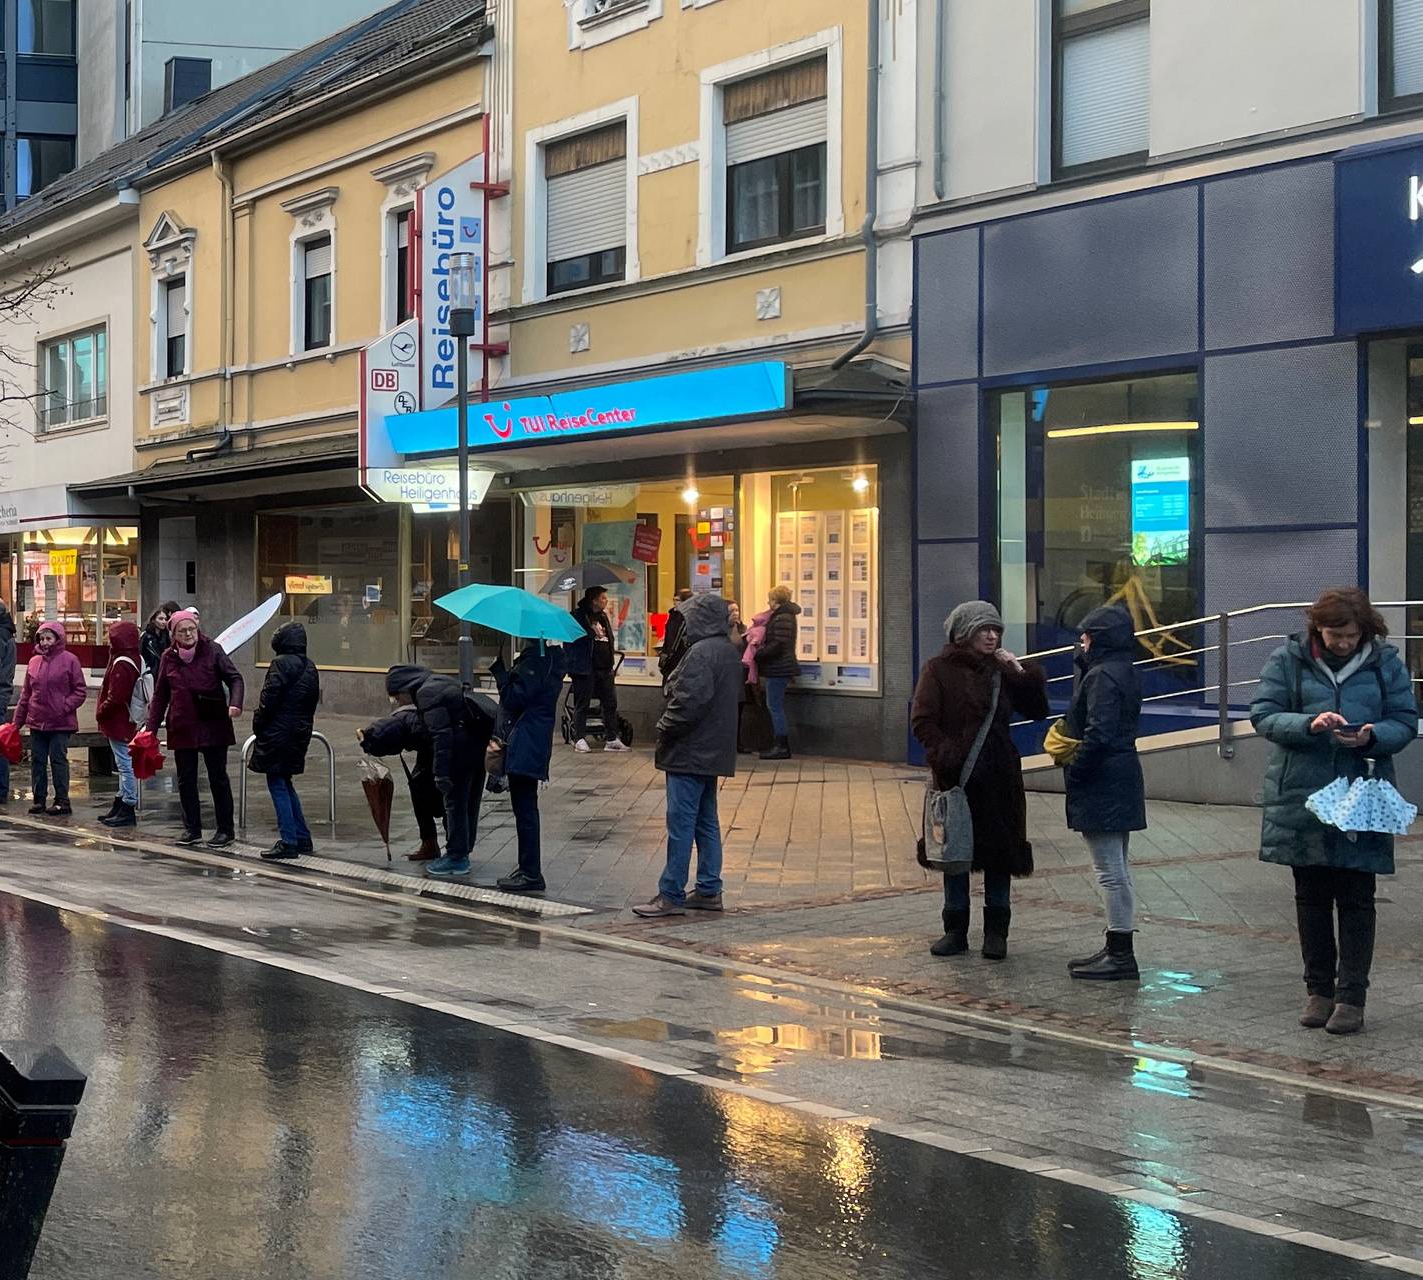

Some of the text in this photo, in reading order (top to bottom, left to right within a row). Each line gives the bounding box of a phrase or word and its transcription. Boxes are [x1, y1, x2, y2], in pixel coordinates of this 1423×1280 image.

[432, 186, 456, 390] Reisebüro
[374, 372, 396, 388] DB
[520, 408, 637, 434] TUI ReiseCenter
[384, 470, 445, 485] Reisebüro
